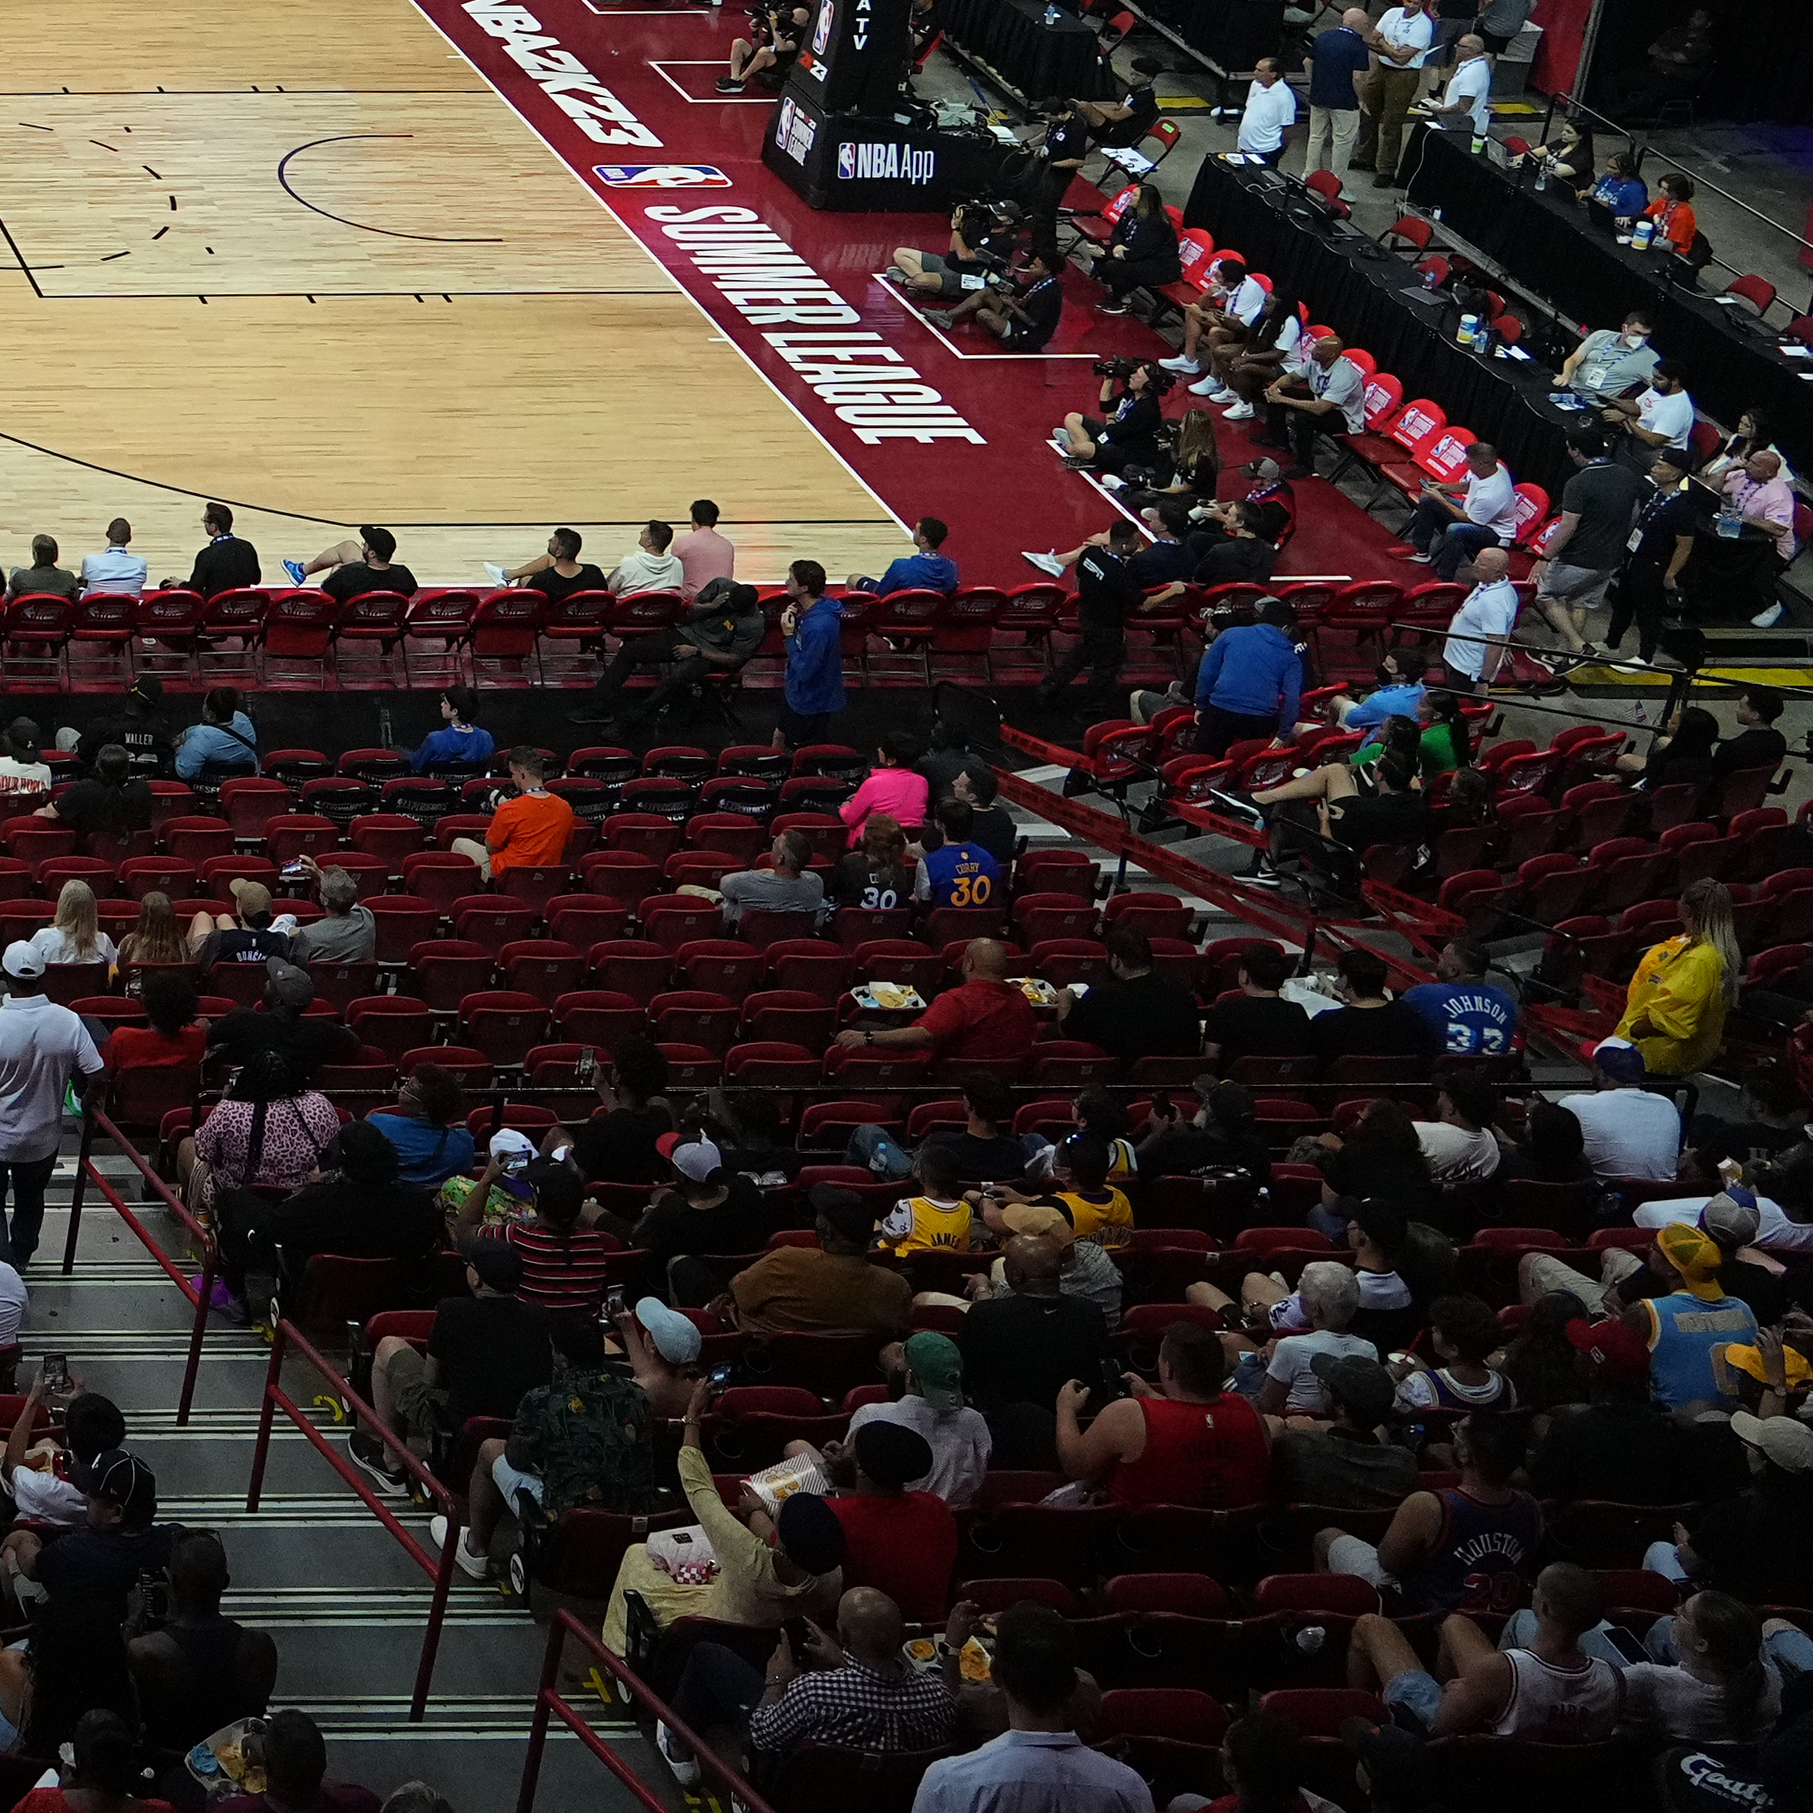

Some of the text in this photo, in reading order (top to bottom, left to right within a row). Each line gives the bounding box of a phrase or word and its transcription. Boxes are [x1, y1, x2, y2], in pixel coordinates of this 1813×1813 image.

[853, 18, 870, 50] TV
[857, 143, 935, 185] NBA App
[645, 205, 986, 445] SUMMER LEAGUE
[125, 733, 154, 746] WALLER
[956, 860, 980, 874] CURRY
[859, 886, 897, 911] 30
[950, 874, 991, 908] 30
[1442, 995, 1508, 1026] JOHNSON
[931, 1232, 962, 1249] JAMES
[1453, 1531, 1522, 1567] HOUSTON
